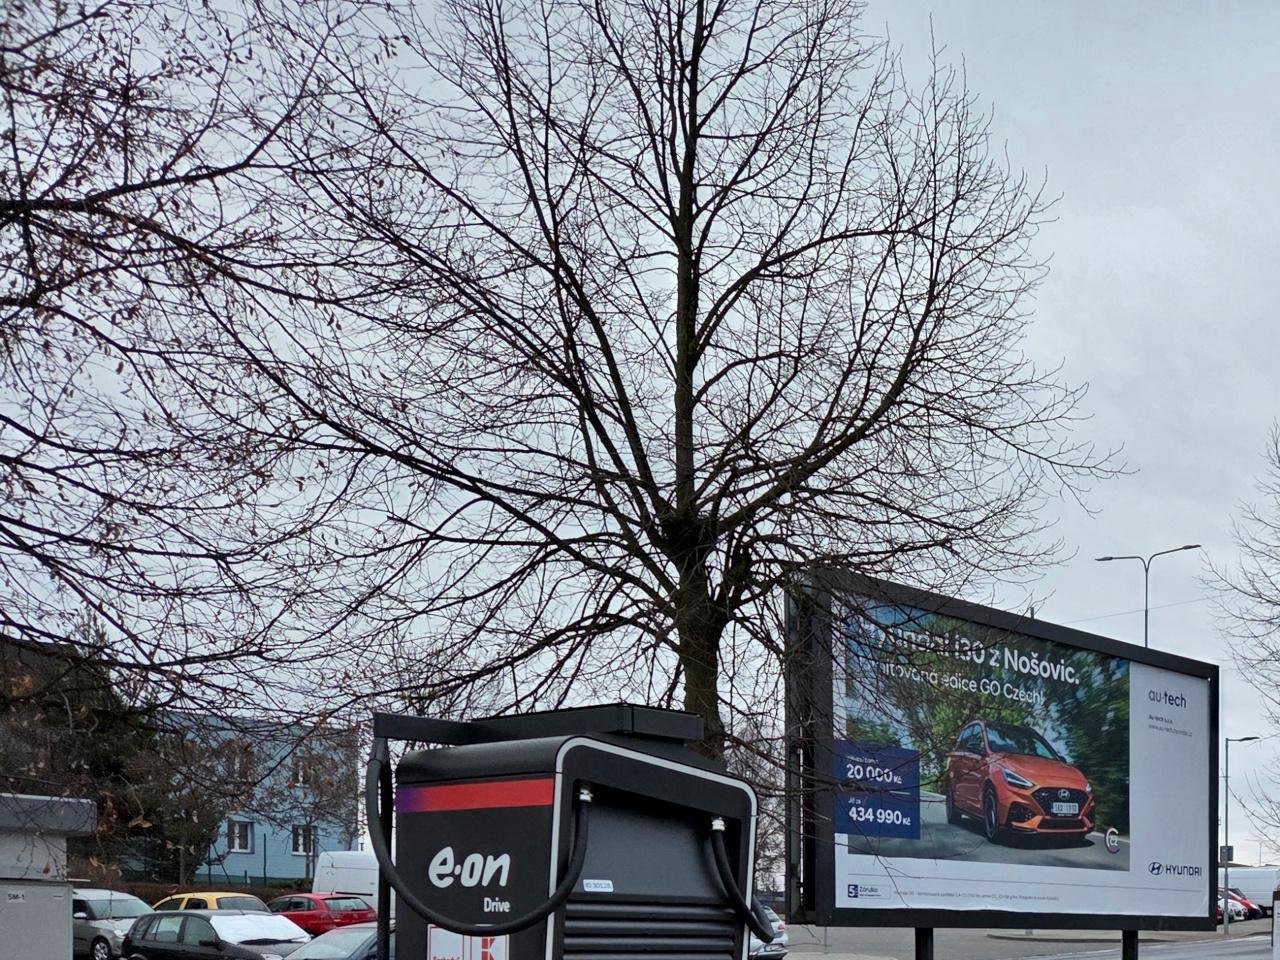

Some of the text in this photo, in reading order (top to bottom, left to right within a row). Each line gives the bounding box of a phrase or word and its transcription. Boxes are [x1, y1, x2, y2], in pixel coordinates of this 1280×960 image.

[990, 646, 1000, 667] z
[1004, 647, 1080, 685] Nošovic.
[980, 678, 1001, 696] GO
[846, 763, 864, 779] 20
[848, 806, 874, 822] 434
[876, 809, 902, 824] 990
[1165, 864, 1202, 877] HYUNDAI
[483, 897, 510, 913] Drive
